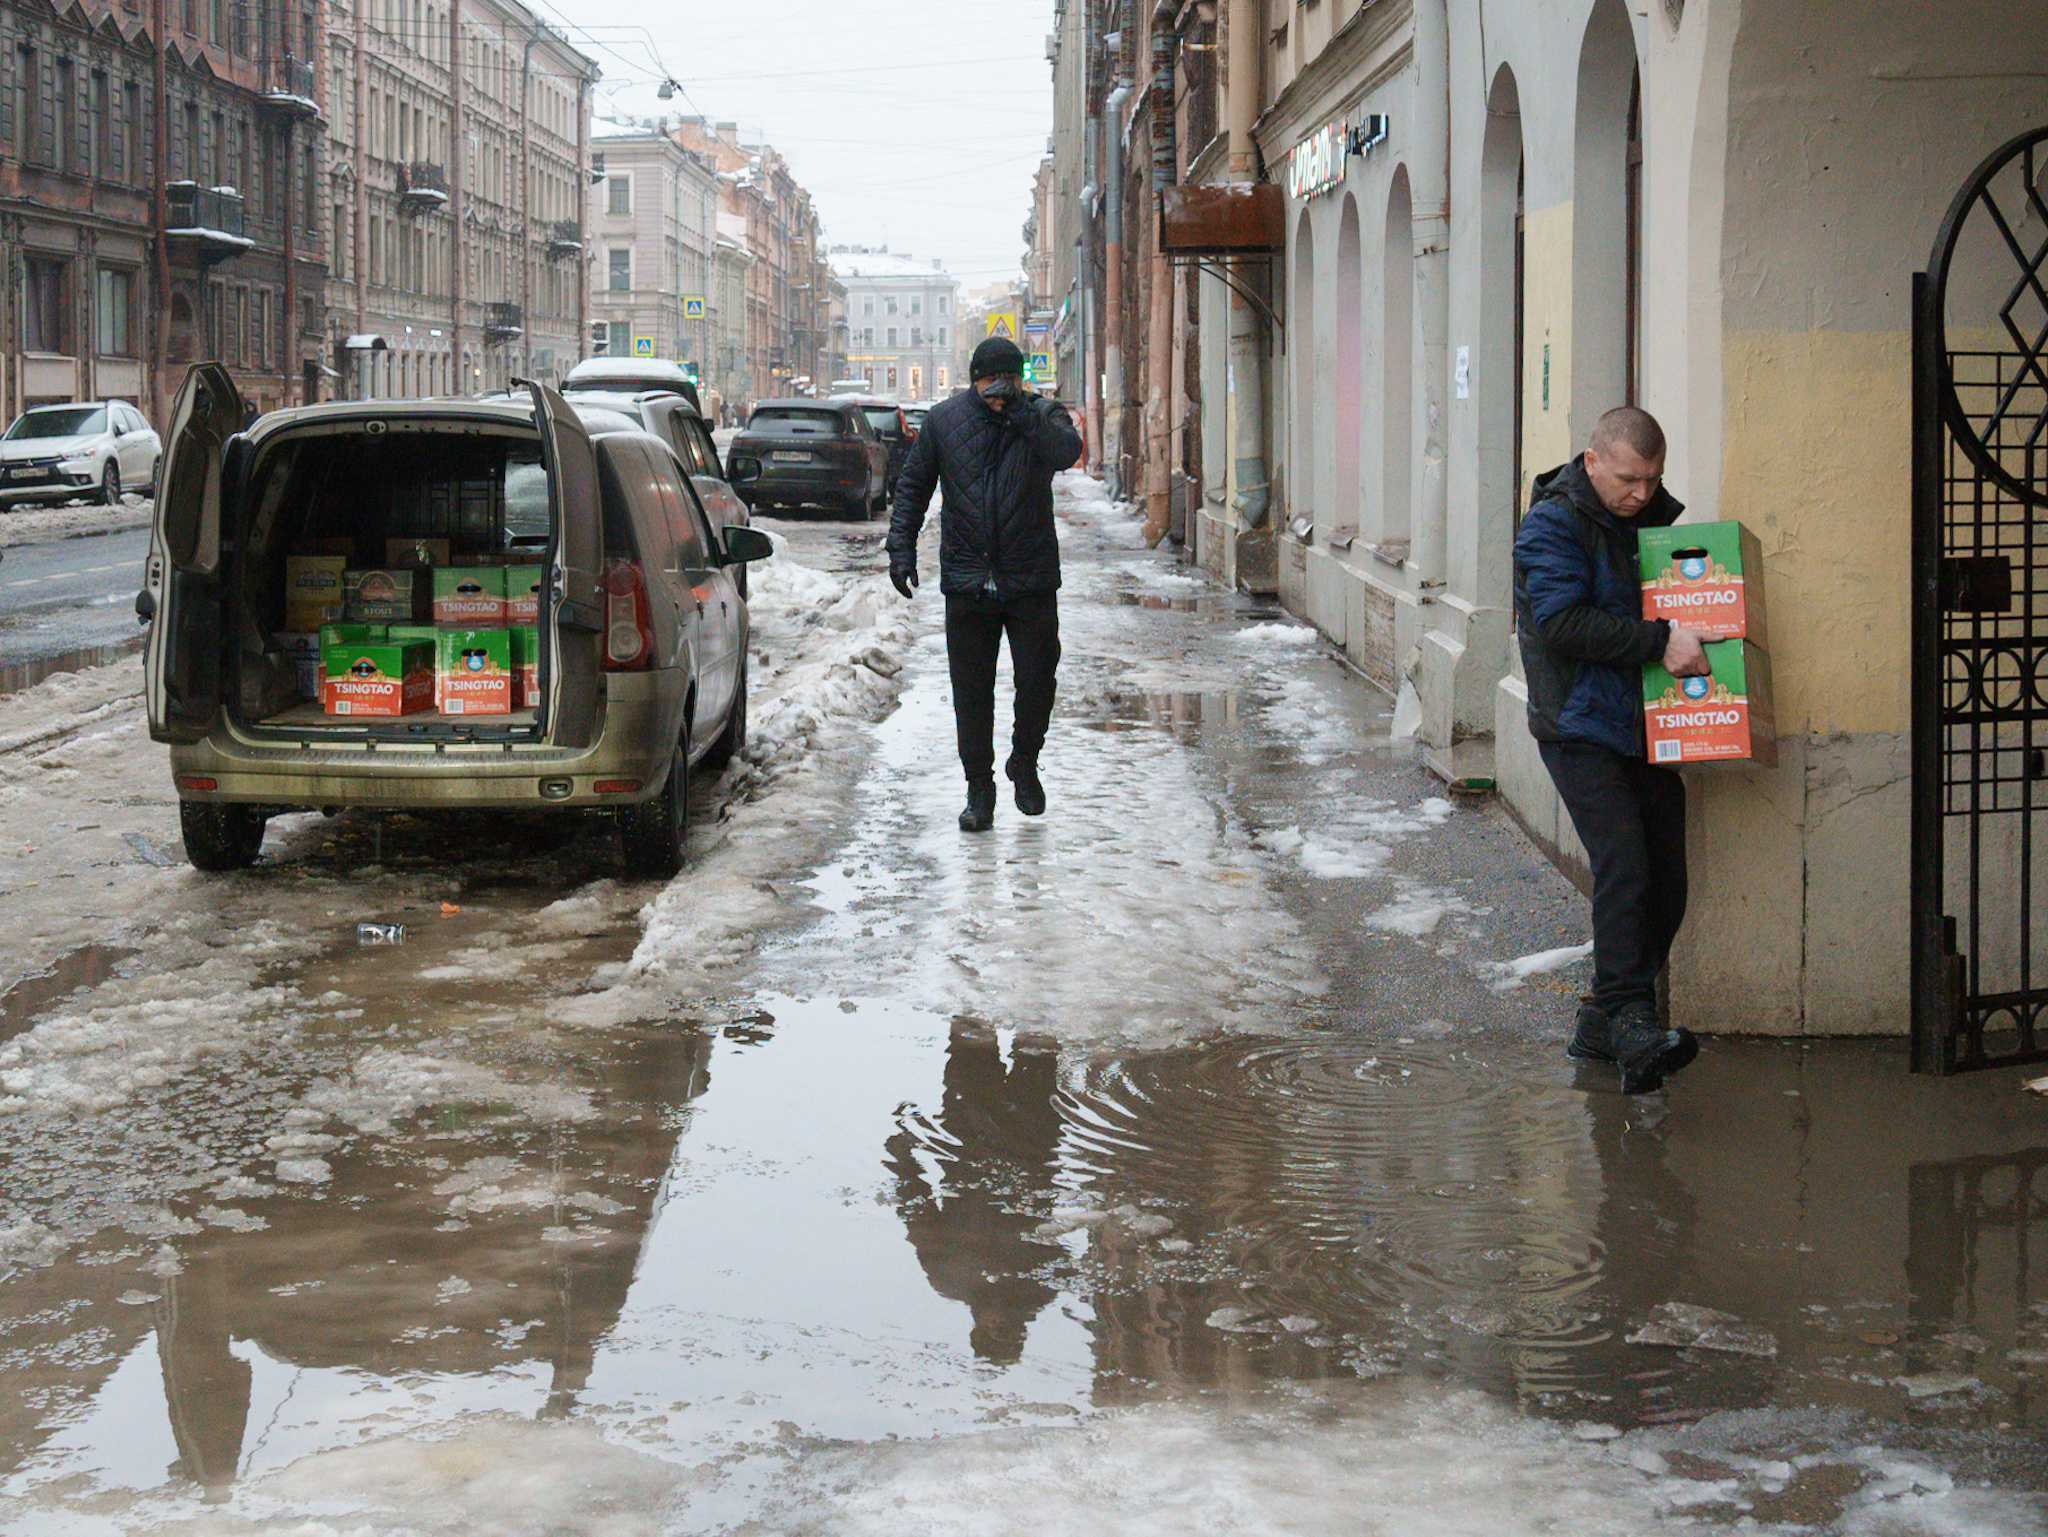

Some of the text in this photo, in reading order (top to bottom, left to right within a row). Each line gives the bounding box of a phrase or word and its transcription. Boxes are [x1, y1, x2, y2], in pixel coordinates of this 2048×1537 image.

[1653, 590, 1737, 608] TSINGTAO
[440, 602, 498, 612] TSINGTAO
[334, 683, 394, 695] TSINGTAO
[447, 680, 505, 691] TSINGTAO
[1655, 710, 1740, 729] TSINGTAO
